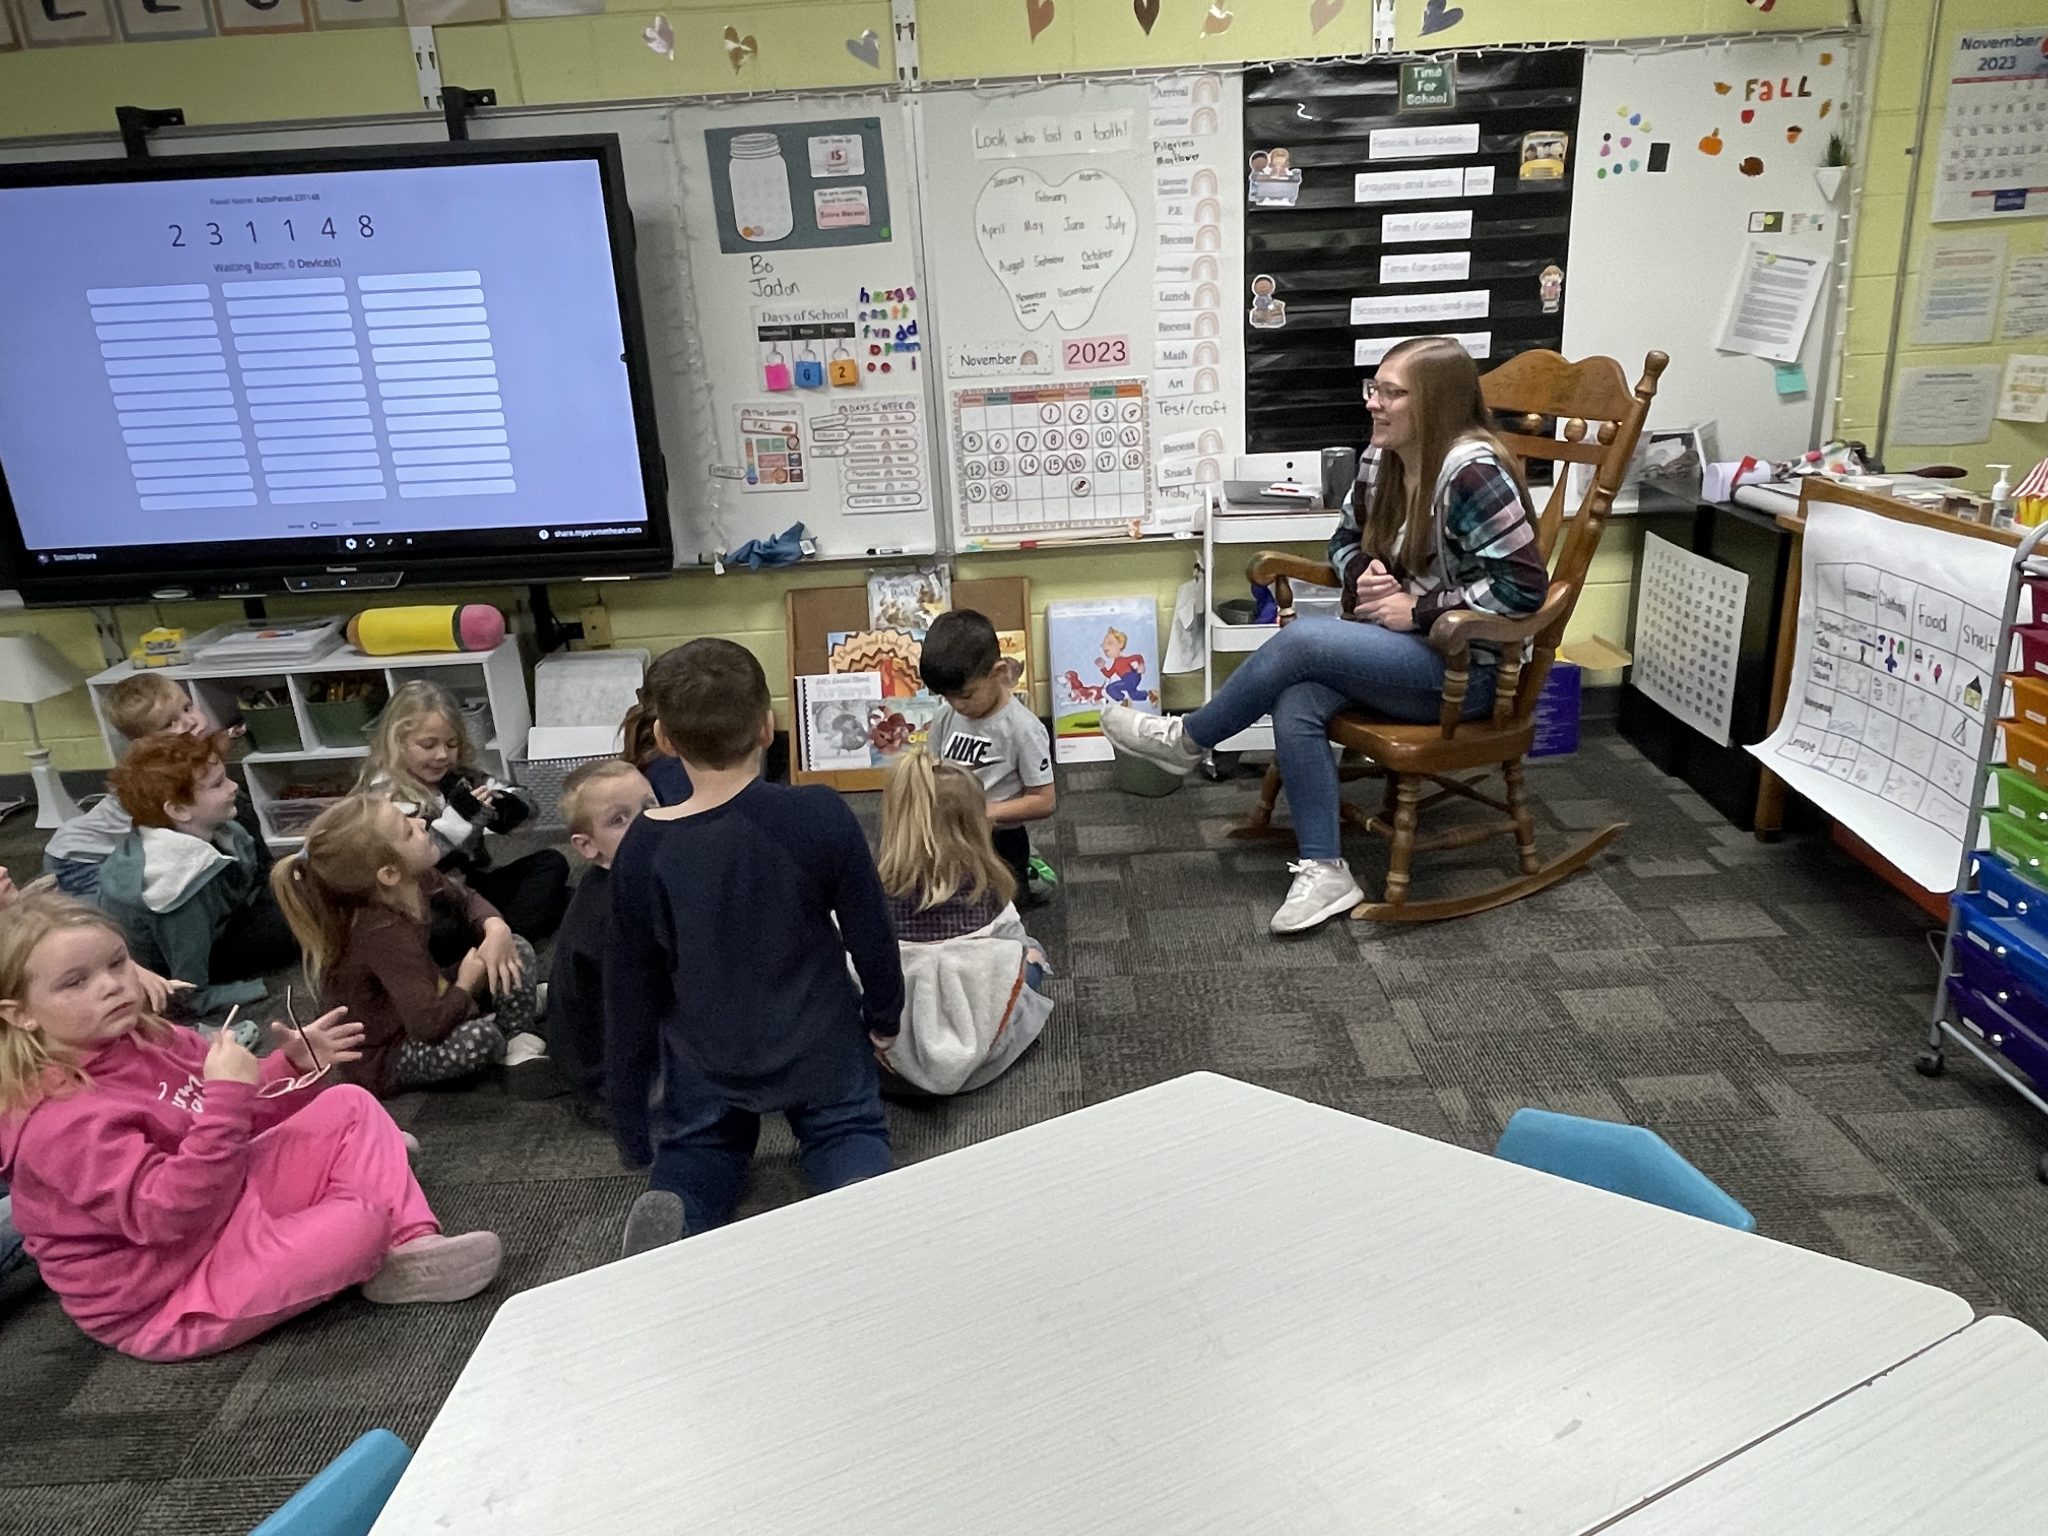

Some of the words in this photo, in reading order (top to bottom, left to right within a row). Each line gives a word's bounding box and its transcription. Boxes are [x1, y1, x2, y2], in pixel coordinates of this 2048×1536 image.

[1961, 35, 2041, 50] November
[1977, 56, 2016, 71] 2023
[1413, 67, 1442, 79] Time
[1156, 87, 1188, 97] Arrival
[1417, 81, 1437, 92] For
[1406, 92, 1447, 105] School
[975, 128, 1006, 149] Look
[1015, 131, 1035, 144] who
[1043, 127, 1061, 142] lost
[1074, 131, 1081, 140] a
[1093, 120, 1127, 138] tooth!
[1153, 140, 1195, 152] Pilgrims
[831, 150, 841, 160] 15
[993, 175, 1024, 188] January
[1035, 191, 1067, 203] February
[168, 224, 185, 247] 2
[206, 222, 223, 245] 3
[245, 220, 257, 243] 1
[283, 219, 295, 241] 1
[321, 217, 337, 239] 4
[358, 214, 374, 238] 8
[981, 223, 1005, 238] April
[1024, 221, 1044, 234] May
[1064, 216, 1085, 231] June
[1105, 215, 1126, 235] July
[1160, 235, 1193, 245] Recess
[213, 262, 252, 274] Waiting
[288, 260, 295, 269] 0
[297, 257, 341, 269] Device(s)
[750, 255, 774, 275] Bo
[999, 258, 1025, 274] August
[1081, 249, 1113, 262] October
[749, 278, 800, 297] Jadon
[1159, 292, 1191, 302] Lunch
[762, 312, 791, 323] Days
[794, 310, 806, 320] of
[808, 308, 848, 320] School
[1158, 322, 1191, 332] Recess
[1067, 340, 1126, 365] 2023
[1162, 351, 1187, 361] Math
[961, 354, 1017, 367] November
[838, 366, 846, 378] 2
[1168, 379, 1183, 389] Art
[881, 402, 903, 411] WEEK
[1076, 409, 1083, 419] 2
[1103, 406, 1109, 417] 3
[1129, 408, 1137, 417] 4
[1156, 399, 1227, 416] Test/craft
[753, 421, 772, 430] FALL
[968, 436, 976, 447] 5
[995, 439, 1001, 448] 6
[1023, 436, 1029, 447] 7
[1050, 434, 1056, 445] 8
[1076, 434, 1082, 445] 9
[1101, 431, 1112, 442] 10
[1125, 431, 1135, 441] 11
[1164, 442, 1195, 454] Recess
[970, 465, 981, 476] 12
[994, 461, 1005, 471] 13
[1024, 459, 1034, 470] 14
[1048, 460, 1059, 471] 15
[1070, 458, 1081, 468] 16
[1101, 456, 1111, 467] 17
[1128, 455, 1138, 465] 18
[1164, 467, 1192, 479] Snack
[971, 487, 981, 497] 19
[994, 485, 1007, 496] 20
[1919, 603, 1947, 632] Food
[1963, 624, 1996, 653] Shelt
[945, 735, 992, 762] NIKE
